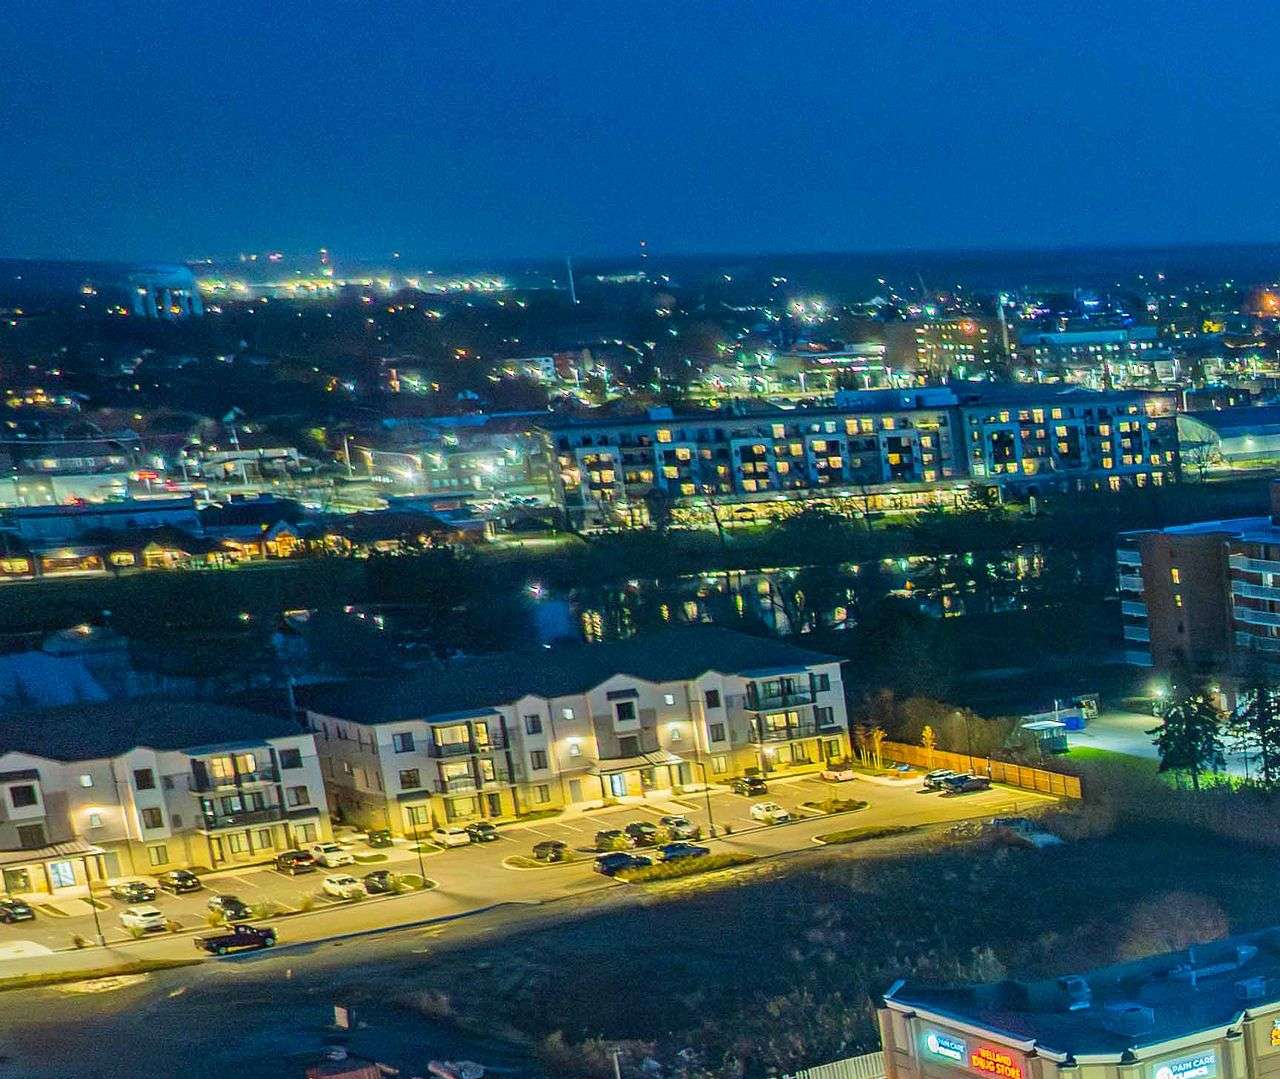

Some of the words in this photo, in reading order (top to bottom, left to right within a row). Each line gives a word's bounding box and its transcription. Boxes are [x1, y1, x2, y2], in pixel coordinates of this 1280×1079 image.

[972, 1055, 995, 1072] DRUG
[980, 1047, 1012, 1066] WELLAND
[1172, 1061, 1192, 1073] PAIN
[1193, 1055, 1215, 1068] CARE
